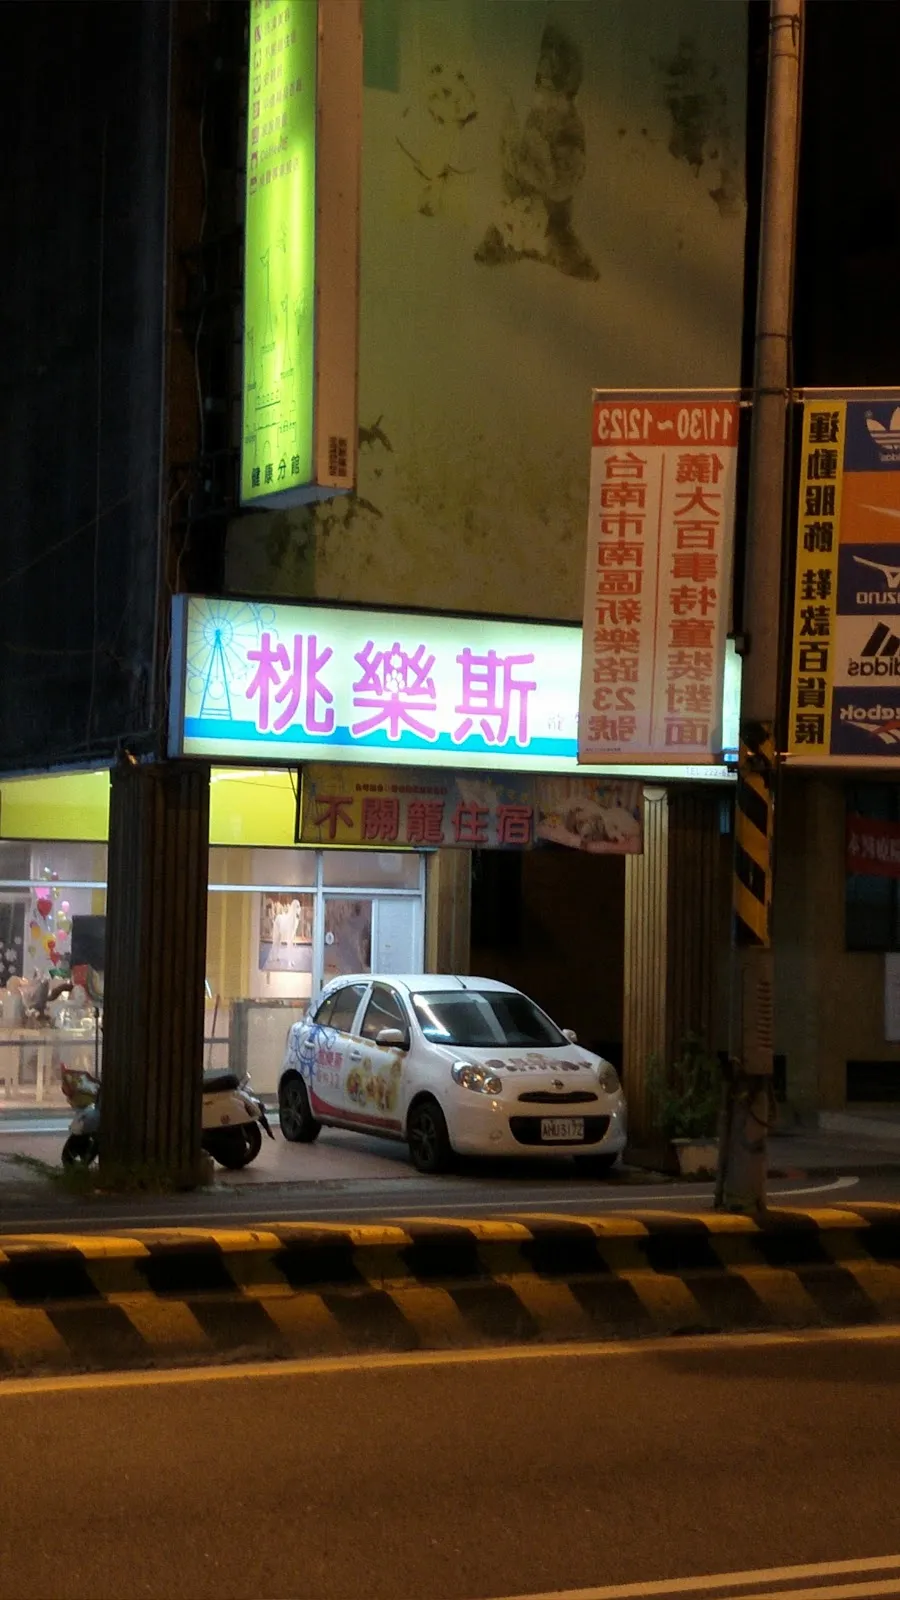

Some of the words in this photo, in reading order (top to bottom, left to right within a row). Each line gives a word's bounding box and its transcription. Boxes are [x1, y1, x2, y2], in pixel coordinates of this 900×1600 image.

[251, 454, 300, 488] 健康分館
[245, 632, 538, 743] 桃樂斯
[313, 794, 534, 846] 不關籠住宿
